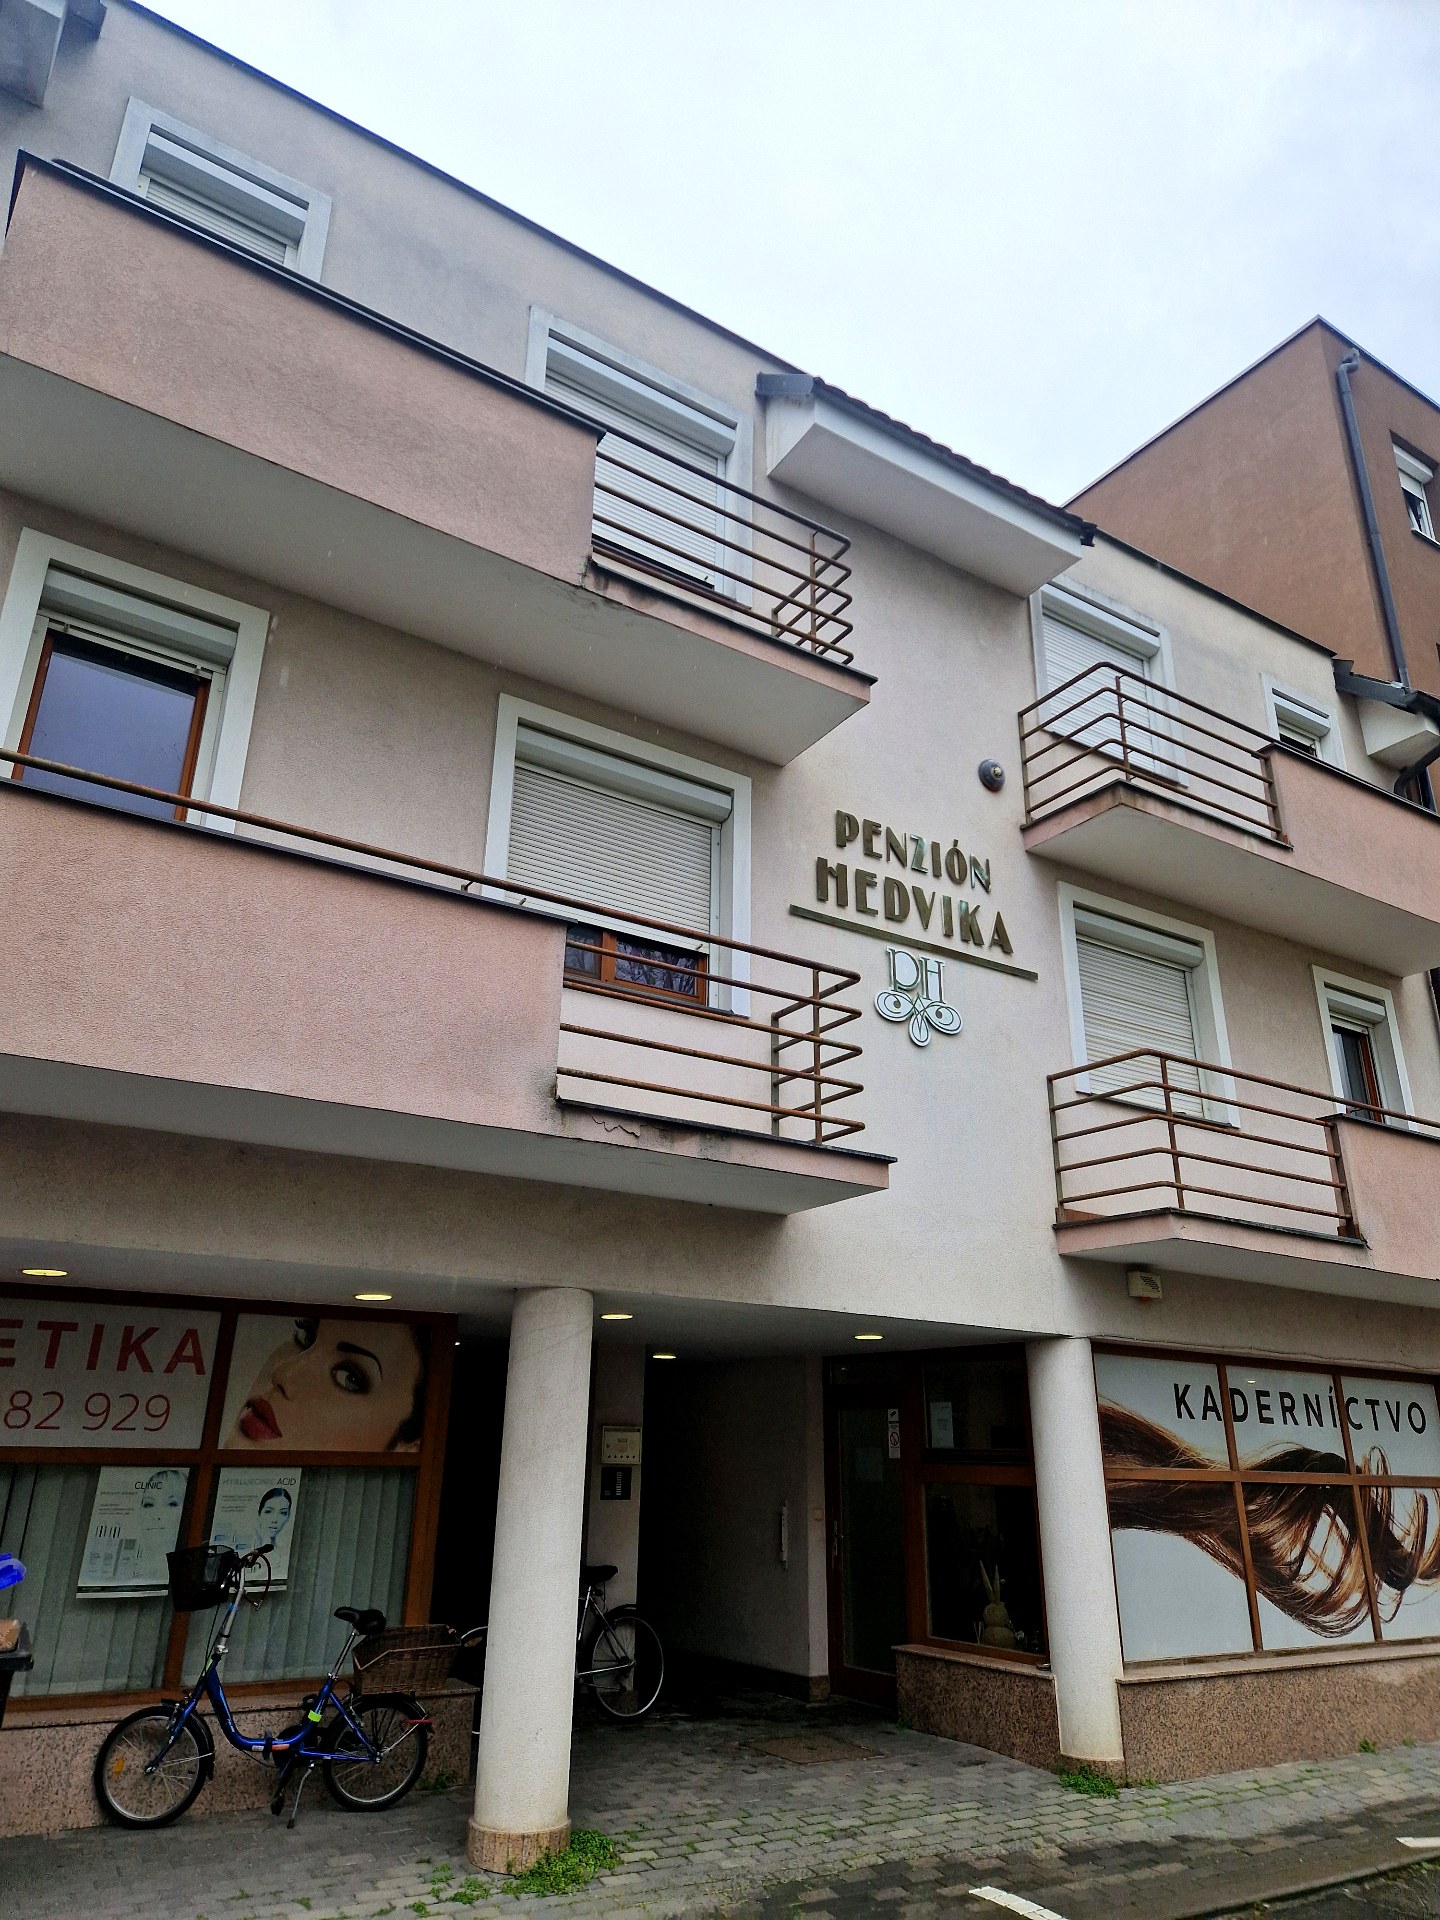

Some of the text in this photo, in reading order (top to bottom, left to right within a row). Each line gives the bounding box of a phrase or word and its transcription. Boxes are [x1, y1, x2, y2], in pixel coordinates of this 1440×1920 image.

[835, 809, 991, 893] PENZIÓN
[815, 856, 1014, 954] HEDVIKA
[3, 1390, 171, 1432] 82 929
[1173, 1382, 1427, 1434] KADERNÍCTVO
[134, 1481, 163, 1490] CLINIC
[277, 1477, 297, 1486] ACID
